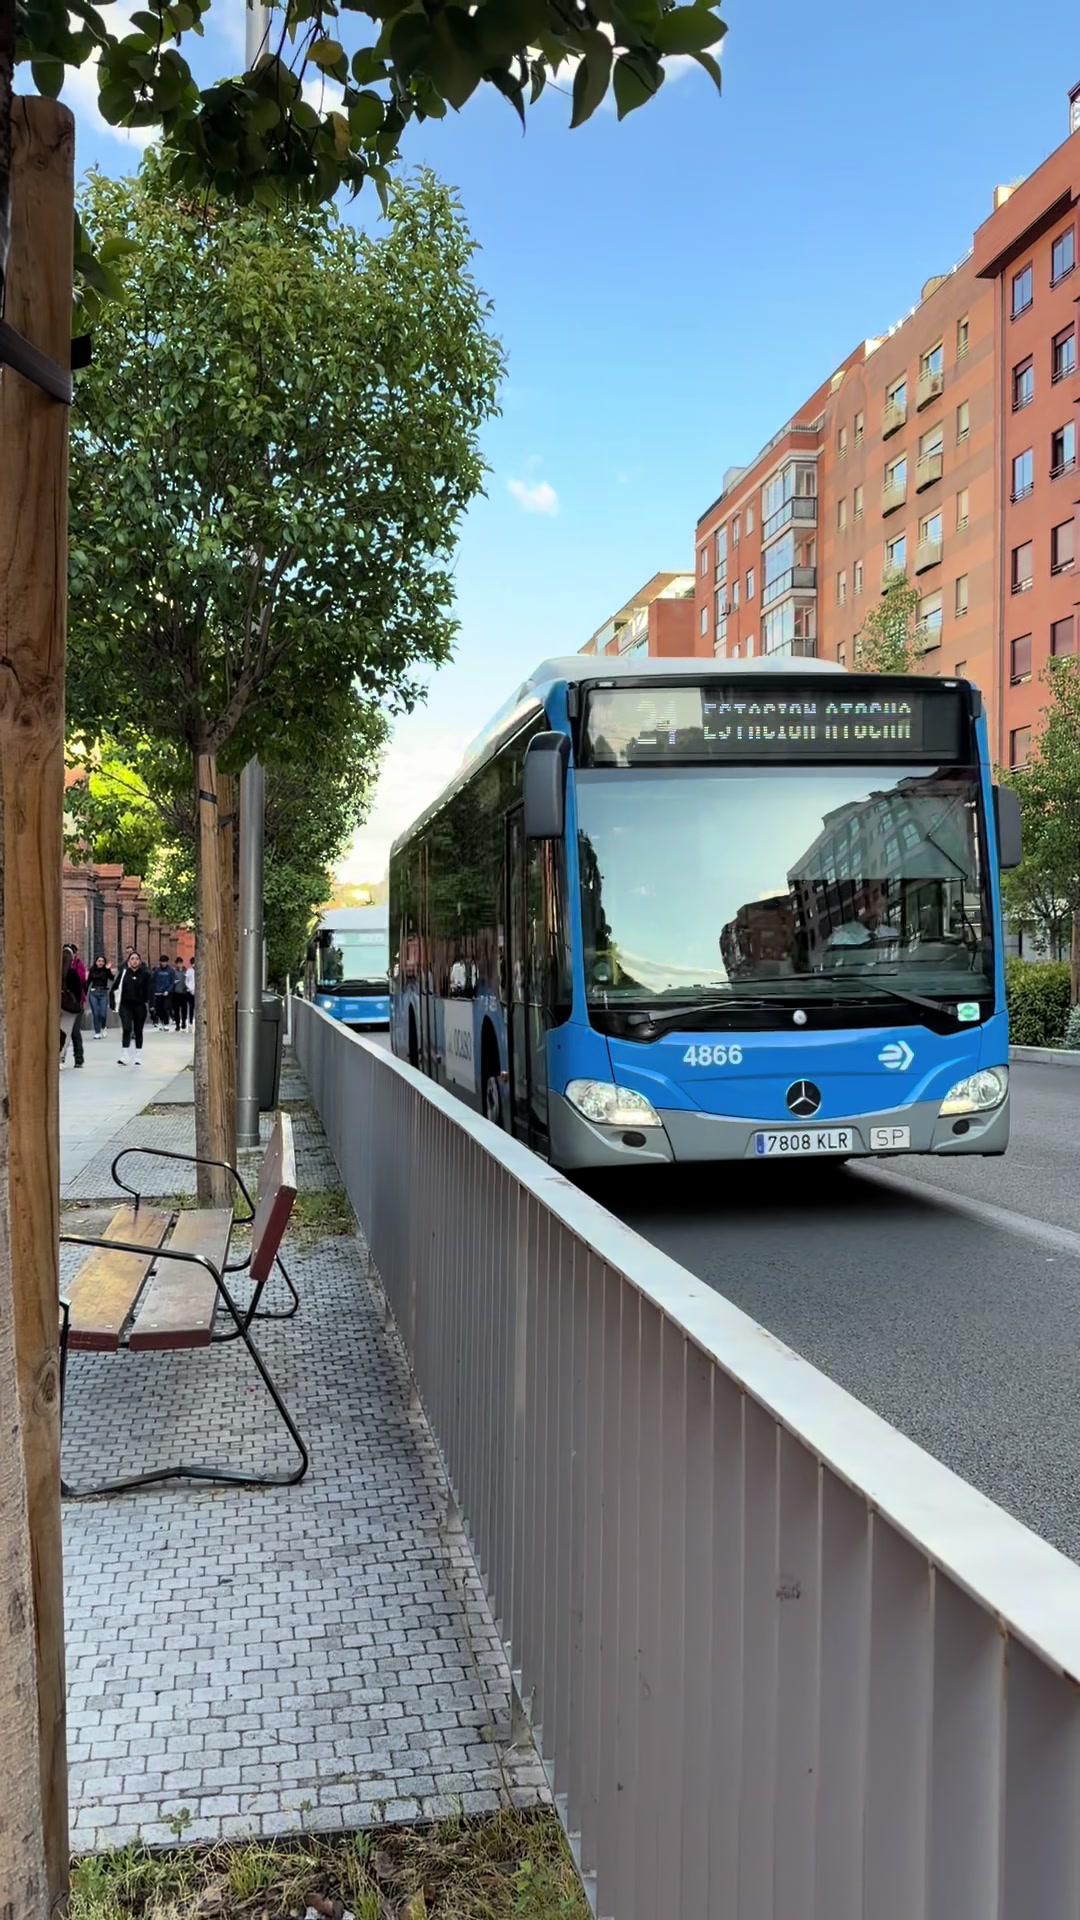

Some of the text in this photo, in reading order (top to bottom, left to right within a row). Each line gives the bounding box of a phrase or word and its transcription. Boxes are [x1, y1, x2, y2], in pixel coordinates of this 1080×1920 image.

[683, 1044, 743, 1066] 4866
[768, 1132, 848, 1152] 7808 KLR
[876, 1129, 904, 1147] SP
